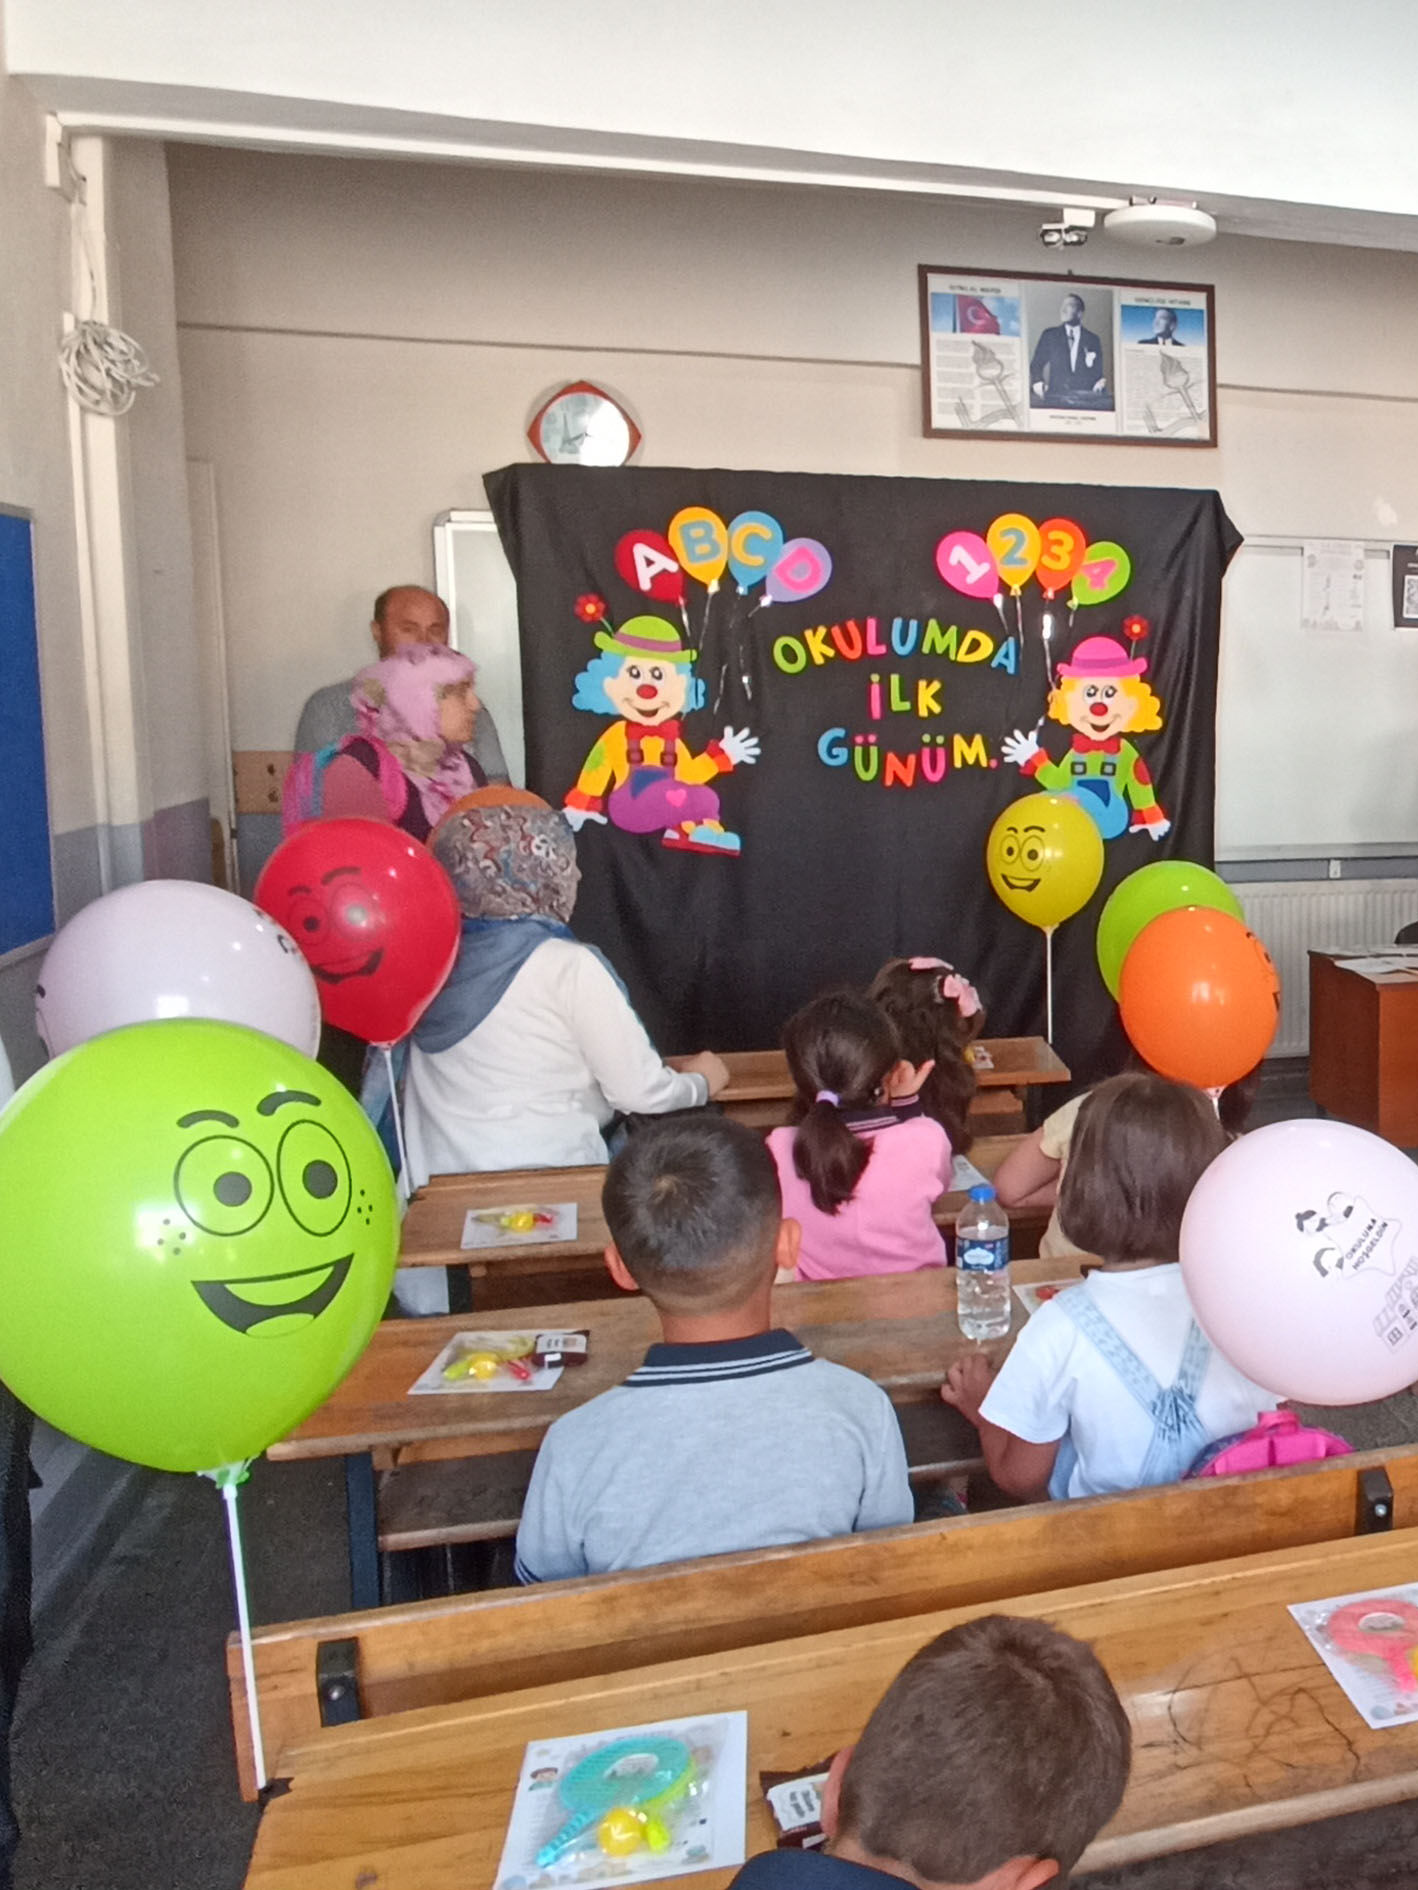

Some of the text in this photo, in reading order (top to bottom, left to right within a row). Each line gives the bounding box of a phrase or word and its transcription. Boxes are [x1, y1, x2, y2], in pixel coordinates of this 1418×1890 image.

[633, 521, 822, 593] A B C D
[949, 528, 1116, 589] 1 2 3 4
[773, 617, 1016, 674] OKULUMDA
[870, 673, 942, 720] İLK
[817, 728, 998, 787] GÜNÜM.
[1345, 1218, 1377, 1260] OKULUNA
